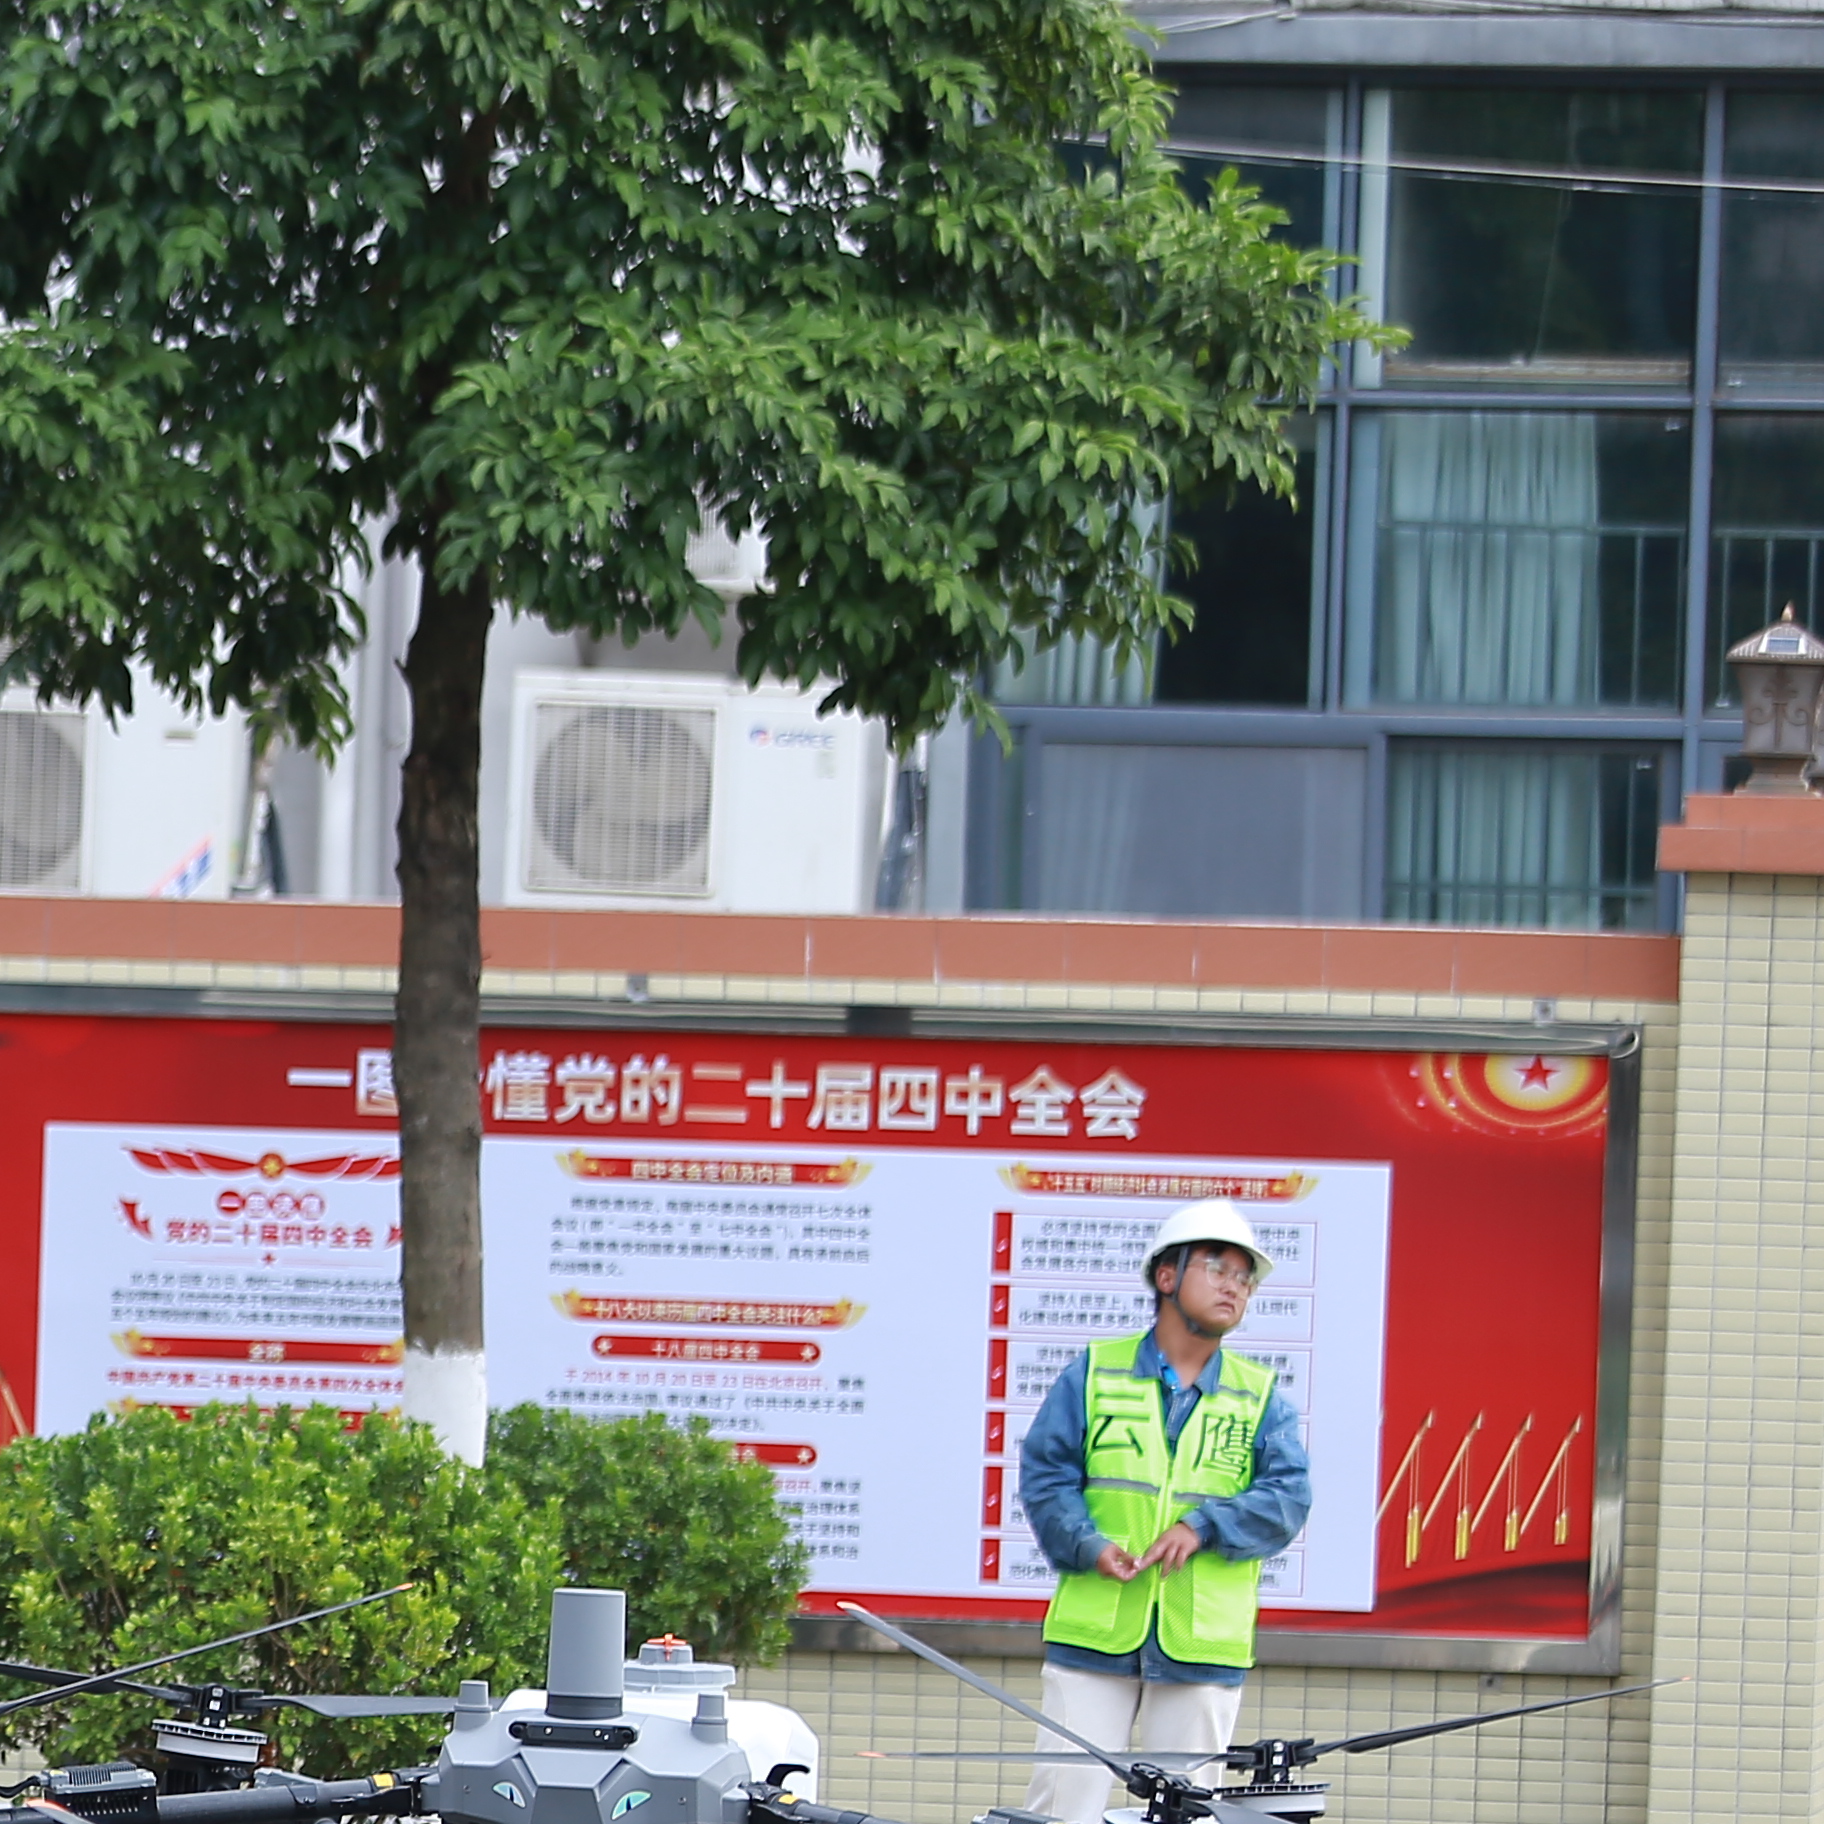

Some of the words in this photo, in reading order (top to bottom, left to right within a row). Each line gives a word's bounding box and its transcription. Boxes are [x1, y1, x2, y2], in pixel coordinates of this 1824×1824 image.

[287, 1050, 1147, 1142] 一图懂党的二十届四中全会
